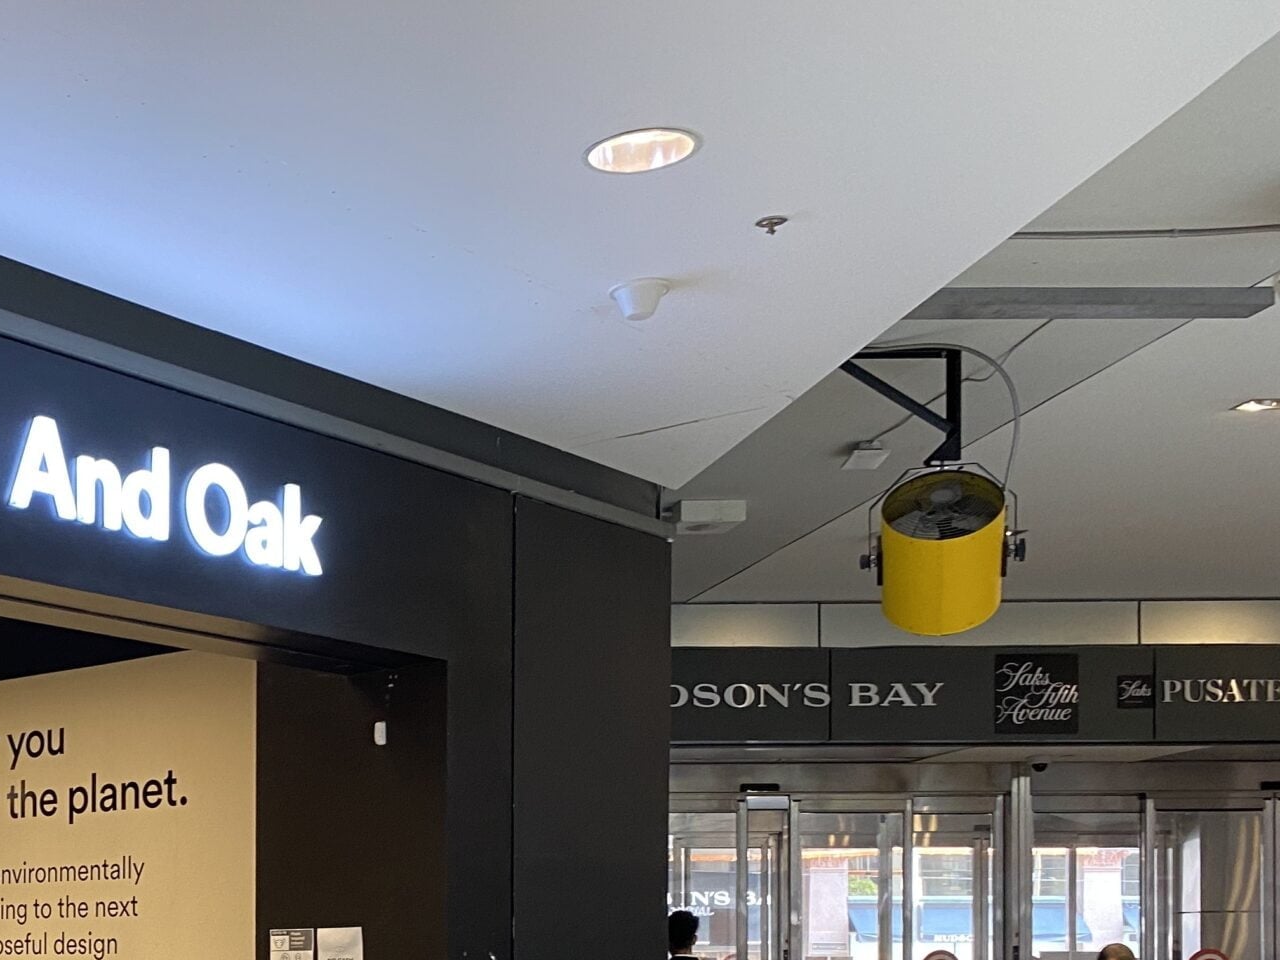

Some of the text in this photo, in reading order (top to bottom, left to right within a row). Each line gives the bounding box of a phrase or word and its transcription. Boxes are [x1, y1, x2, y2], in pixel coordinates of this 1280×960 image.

[8, 415, 170, 541] And
[184, 462, 324, 576] Oak
[995, 662, 1050, 691] Saks
[1119, 681, 1151, 699] Saks
[848, 683, 944, 706] BAY
[1025, 682, 1079, 708] Fifth
[995, 696, 1072, 724] Avenue
[7, 728, 65, 770] you
[7, 780, 58, 818] the
[69, 770, 187, 824] planet.
[33, 898, 52, 919] to
[57, 895, 88, 918] the
[95, 896, 138, 917] next
[53, 931, 118, 960] design
